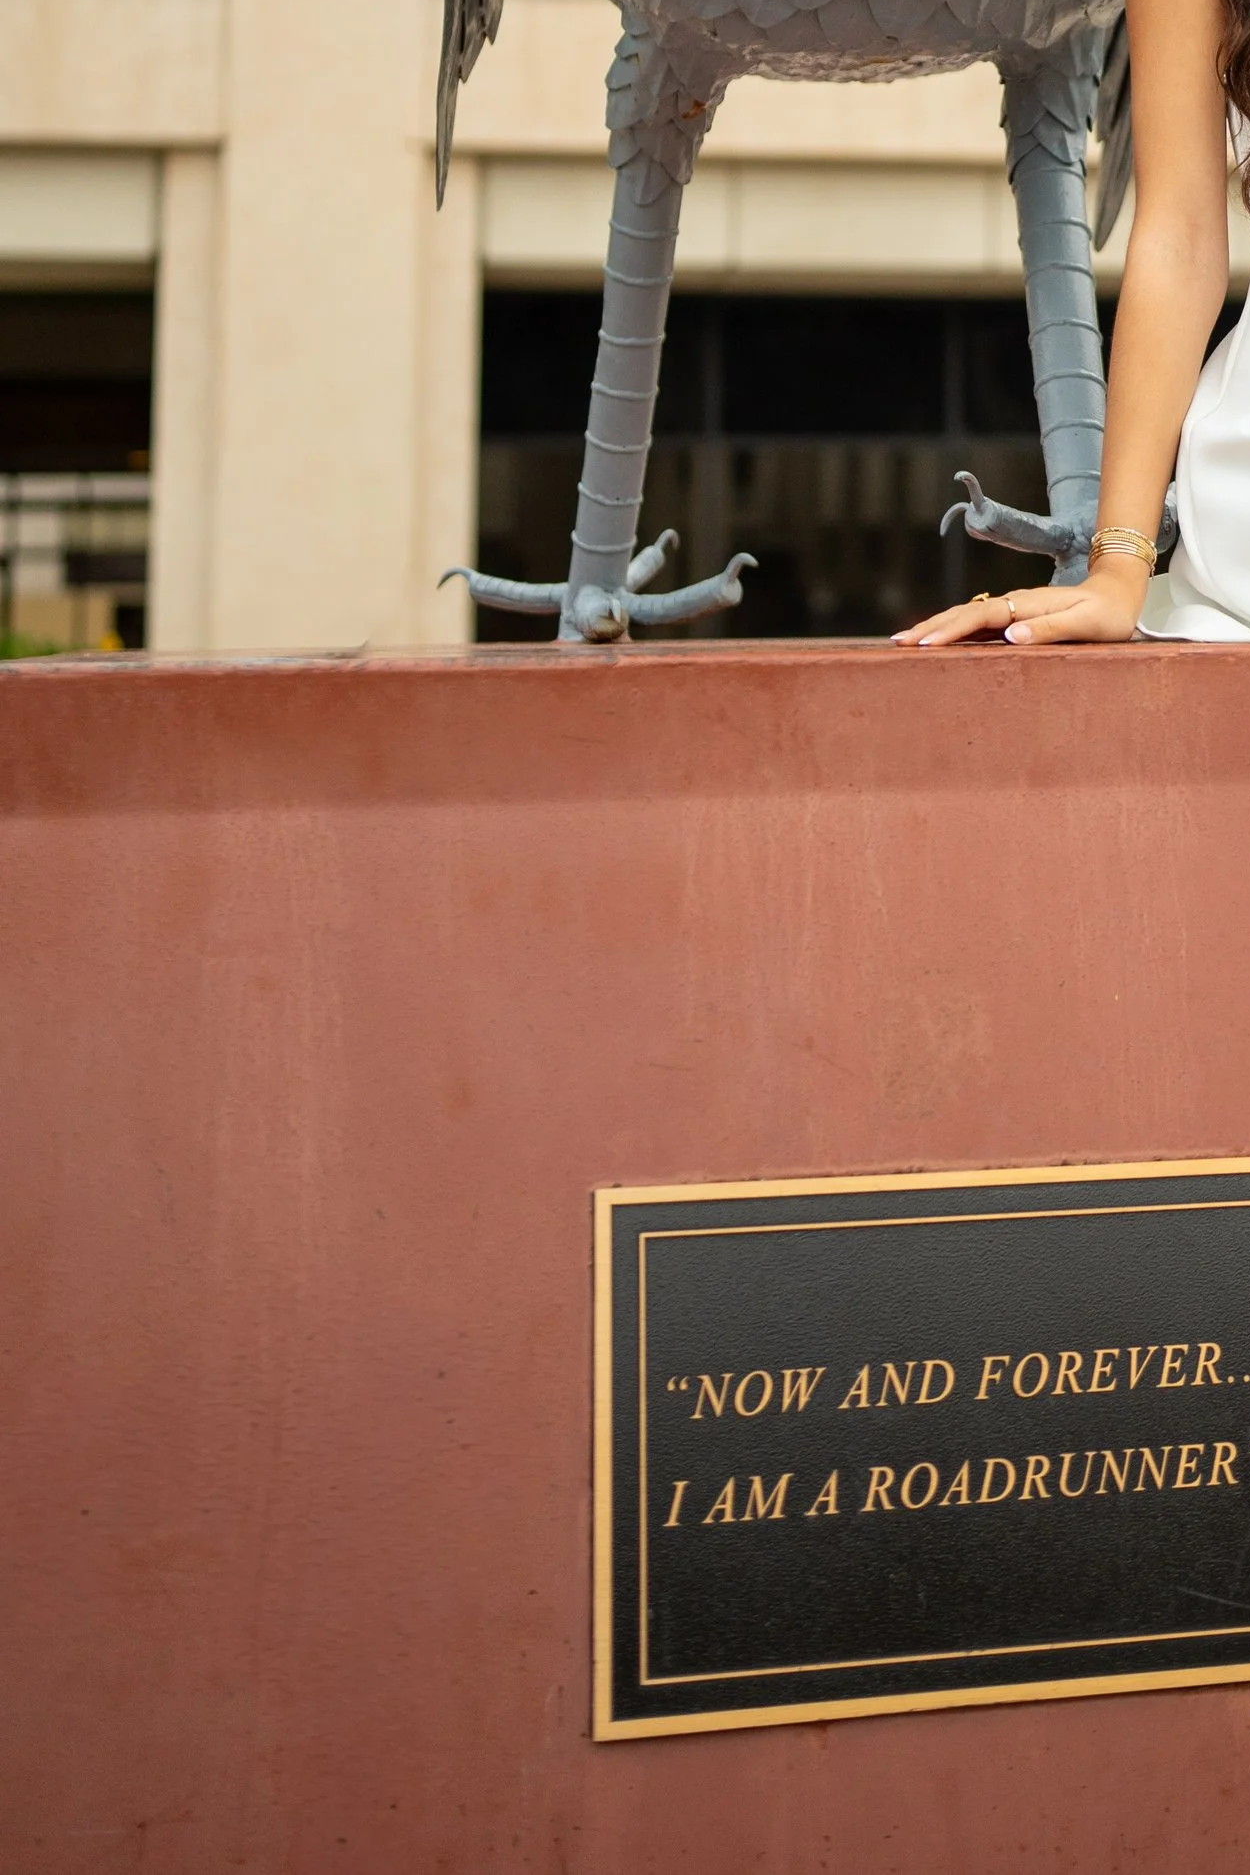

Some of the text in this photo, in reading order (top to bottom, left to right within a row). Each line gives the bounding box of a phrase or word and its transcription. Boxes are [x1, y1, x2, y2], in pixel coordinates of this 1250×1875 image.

[666, 1367, 825, 1420] “NOW
[839, 1359, 956, 1410] AND
[664, 1481, 688, 1527] I
[703, 1473, 792, 1524] AM
[806, 1471, 841, 1517] A
